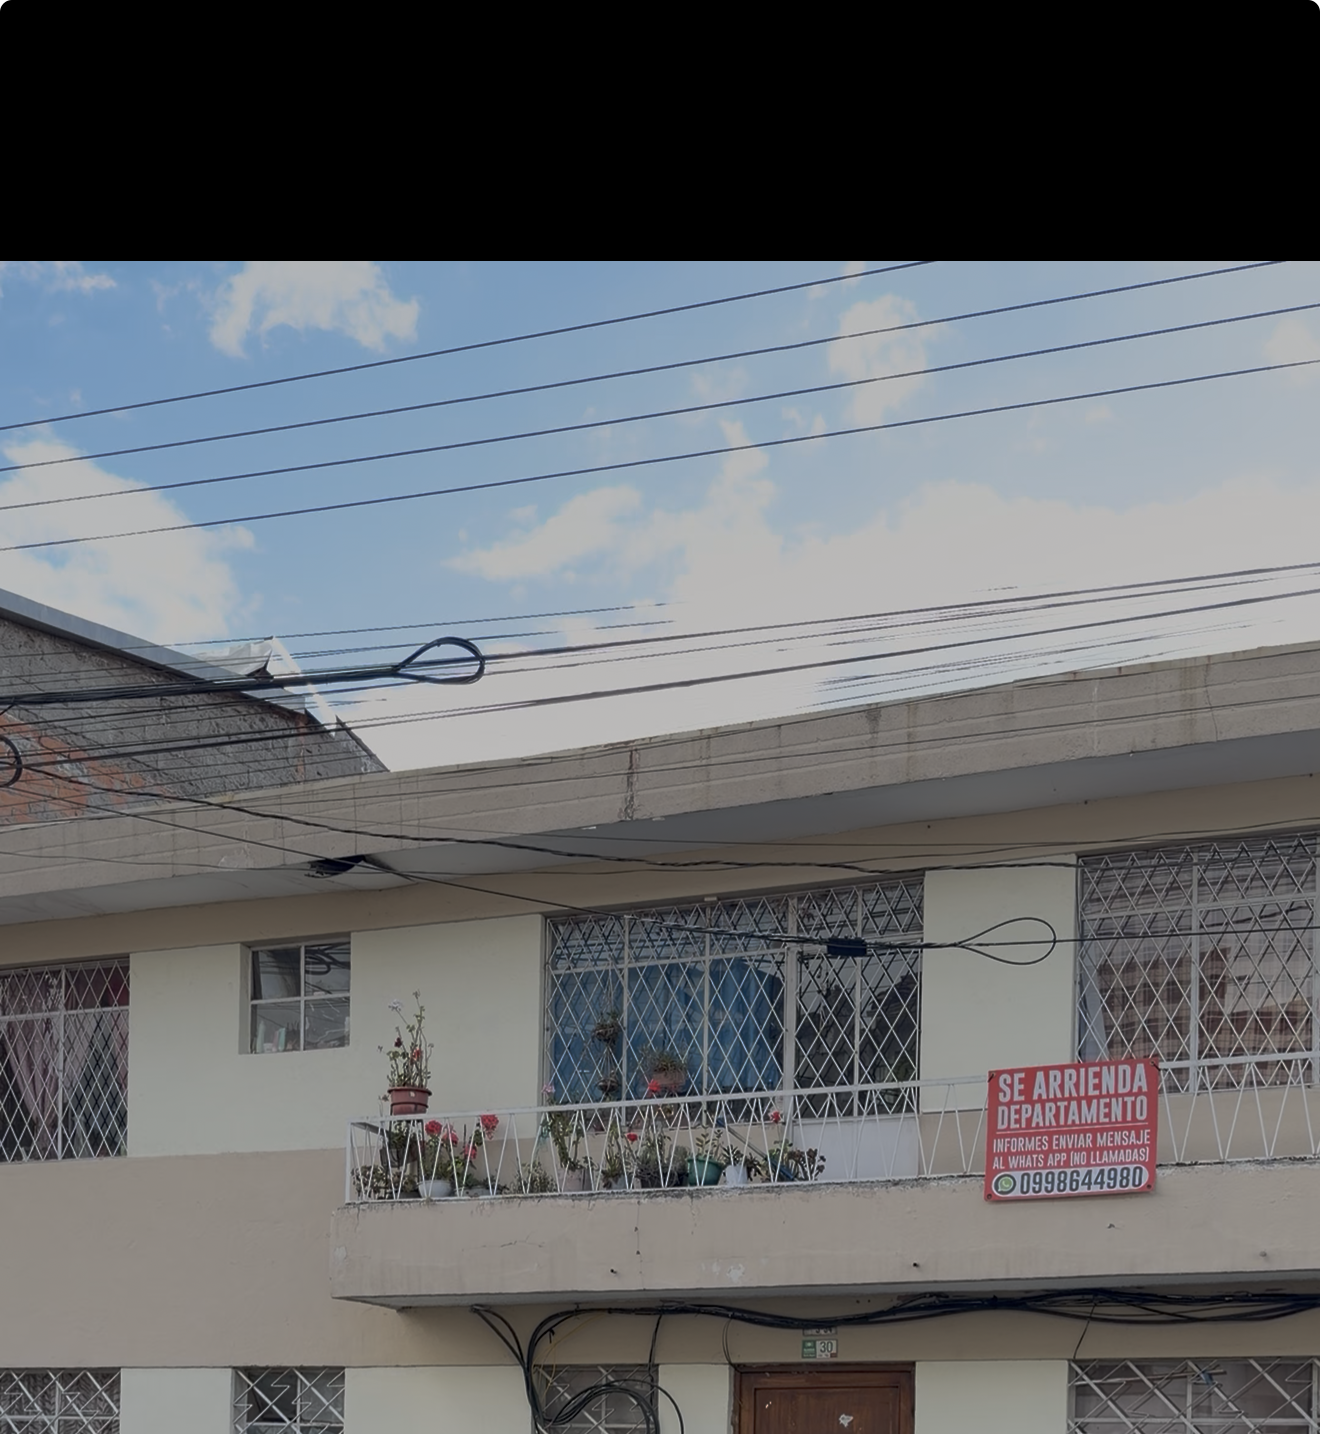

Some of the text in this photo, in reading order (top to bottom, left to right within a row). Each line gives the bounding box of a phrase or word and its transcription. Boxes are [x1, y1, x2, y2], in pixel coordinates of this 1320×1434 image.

[998, 1063, 1148, 1103] SE ARRIENDA
[997, 1095, 1148, 1130] DEPARTAMENTO
[993, 1129, 1151, 1153] INFORMES ENVIAR MENSAJE
[992, 1147, 1149, 1169] AL WHATS APP (NO LLAMADAS)
[1020, 1166, 1143, 1194] 0998644980
[820, 1341, 833, 1353] 30
